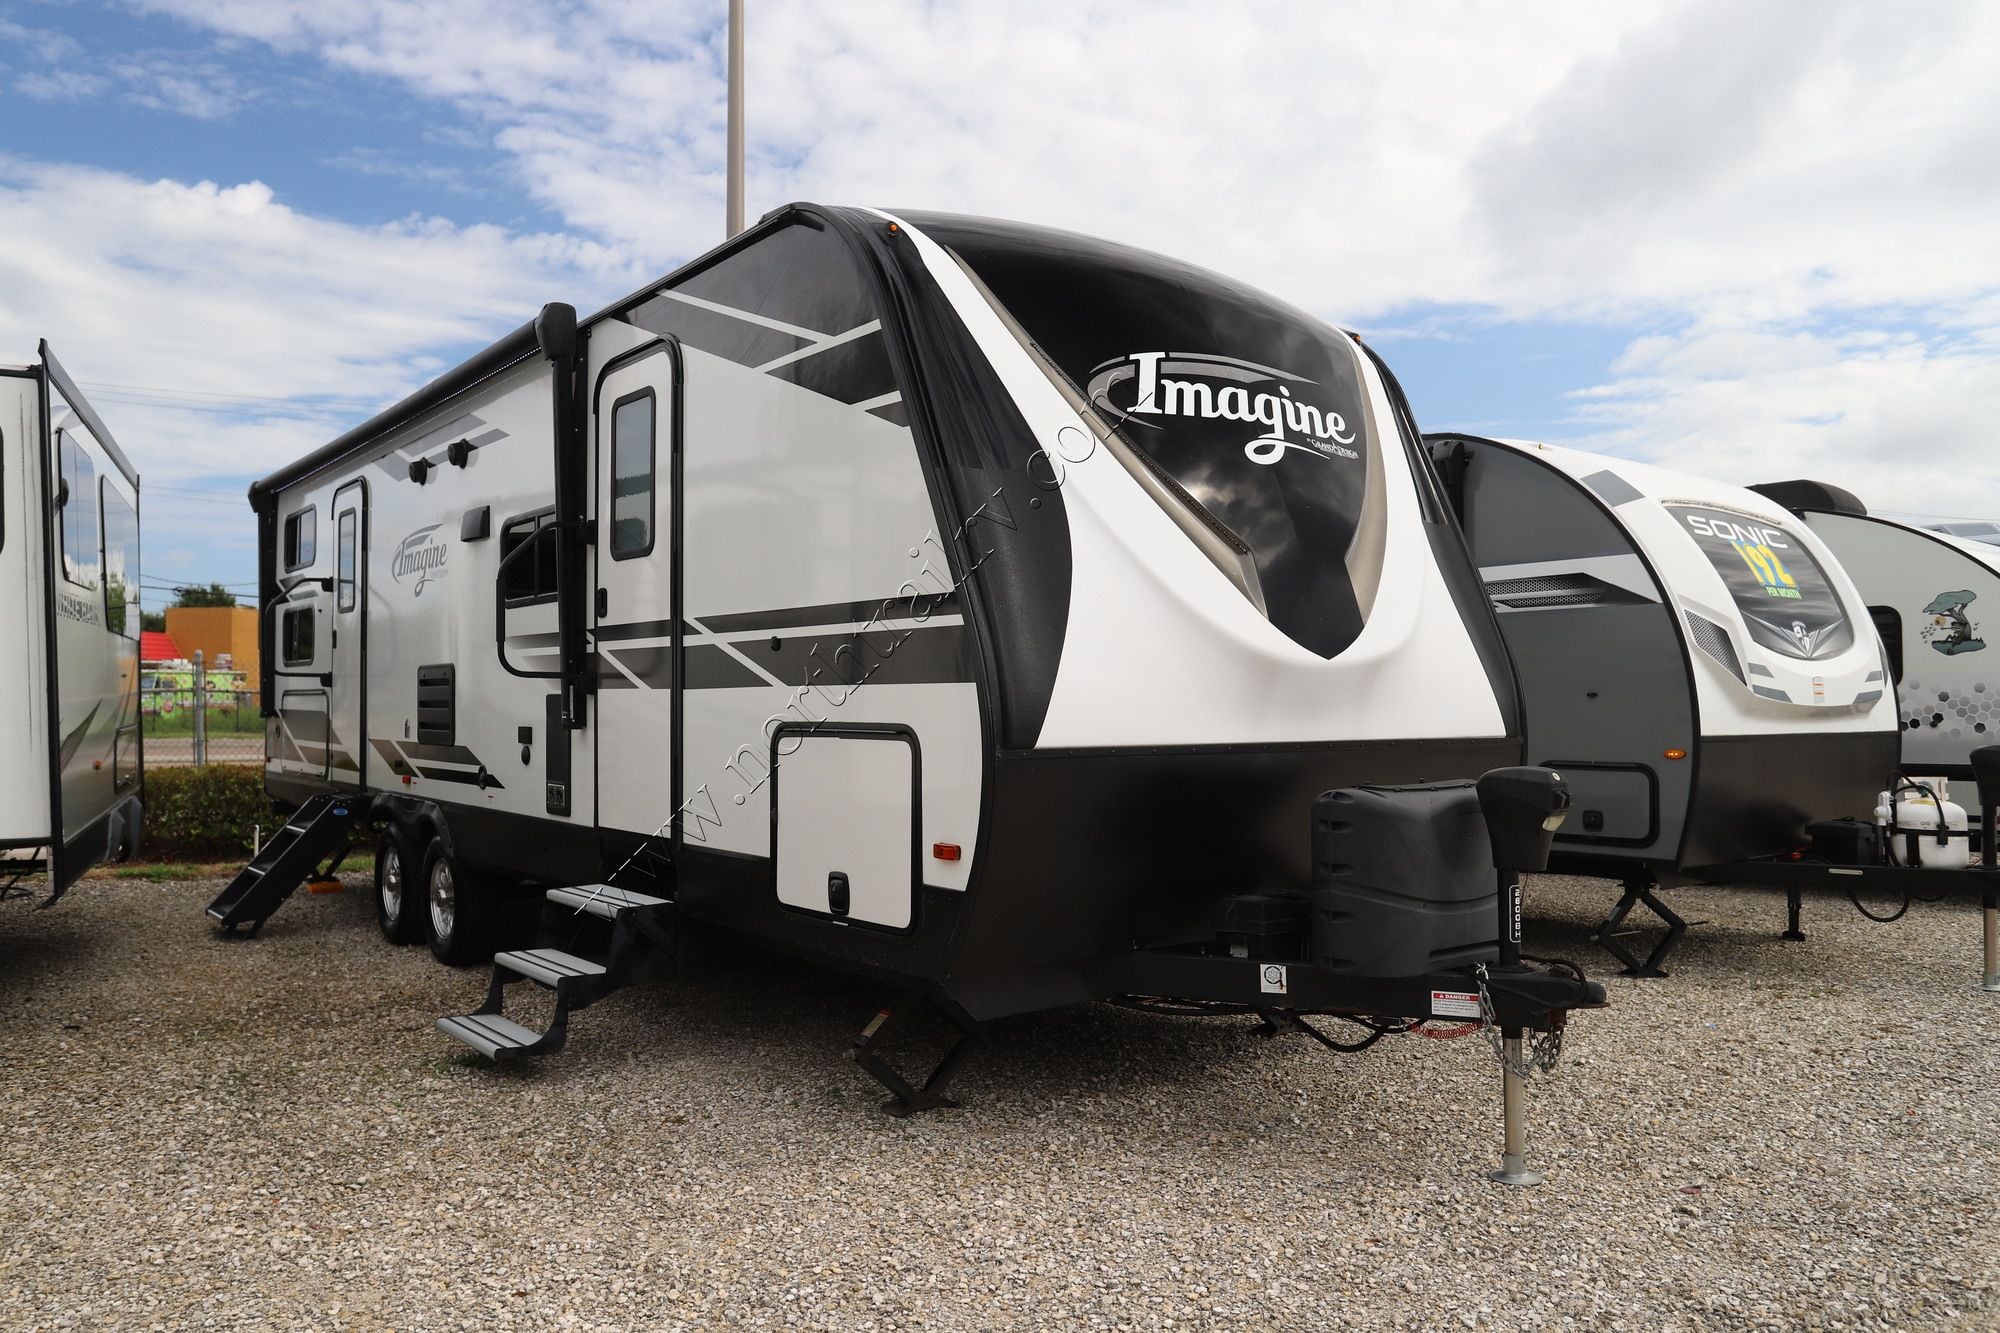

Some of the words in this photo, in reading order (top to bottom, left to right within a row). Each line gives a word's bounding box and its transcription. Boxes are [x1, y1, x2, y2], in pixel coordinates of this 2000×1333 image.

[1127, 352, 1356, 465] Imagine
[1687, 515, 1788, 549] SONIC
[397, 537, 448, 597] Imagine
[1730, 540, 1797, 588] 192
